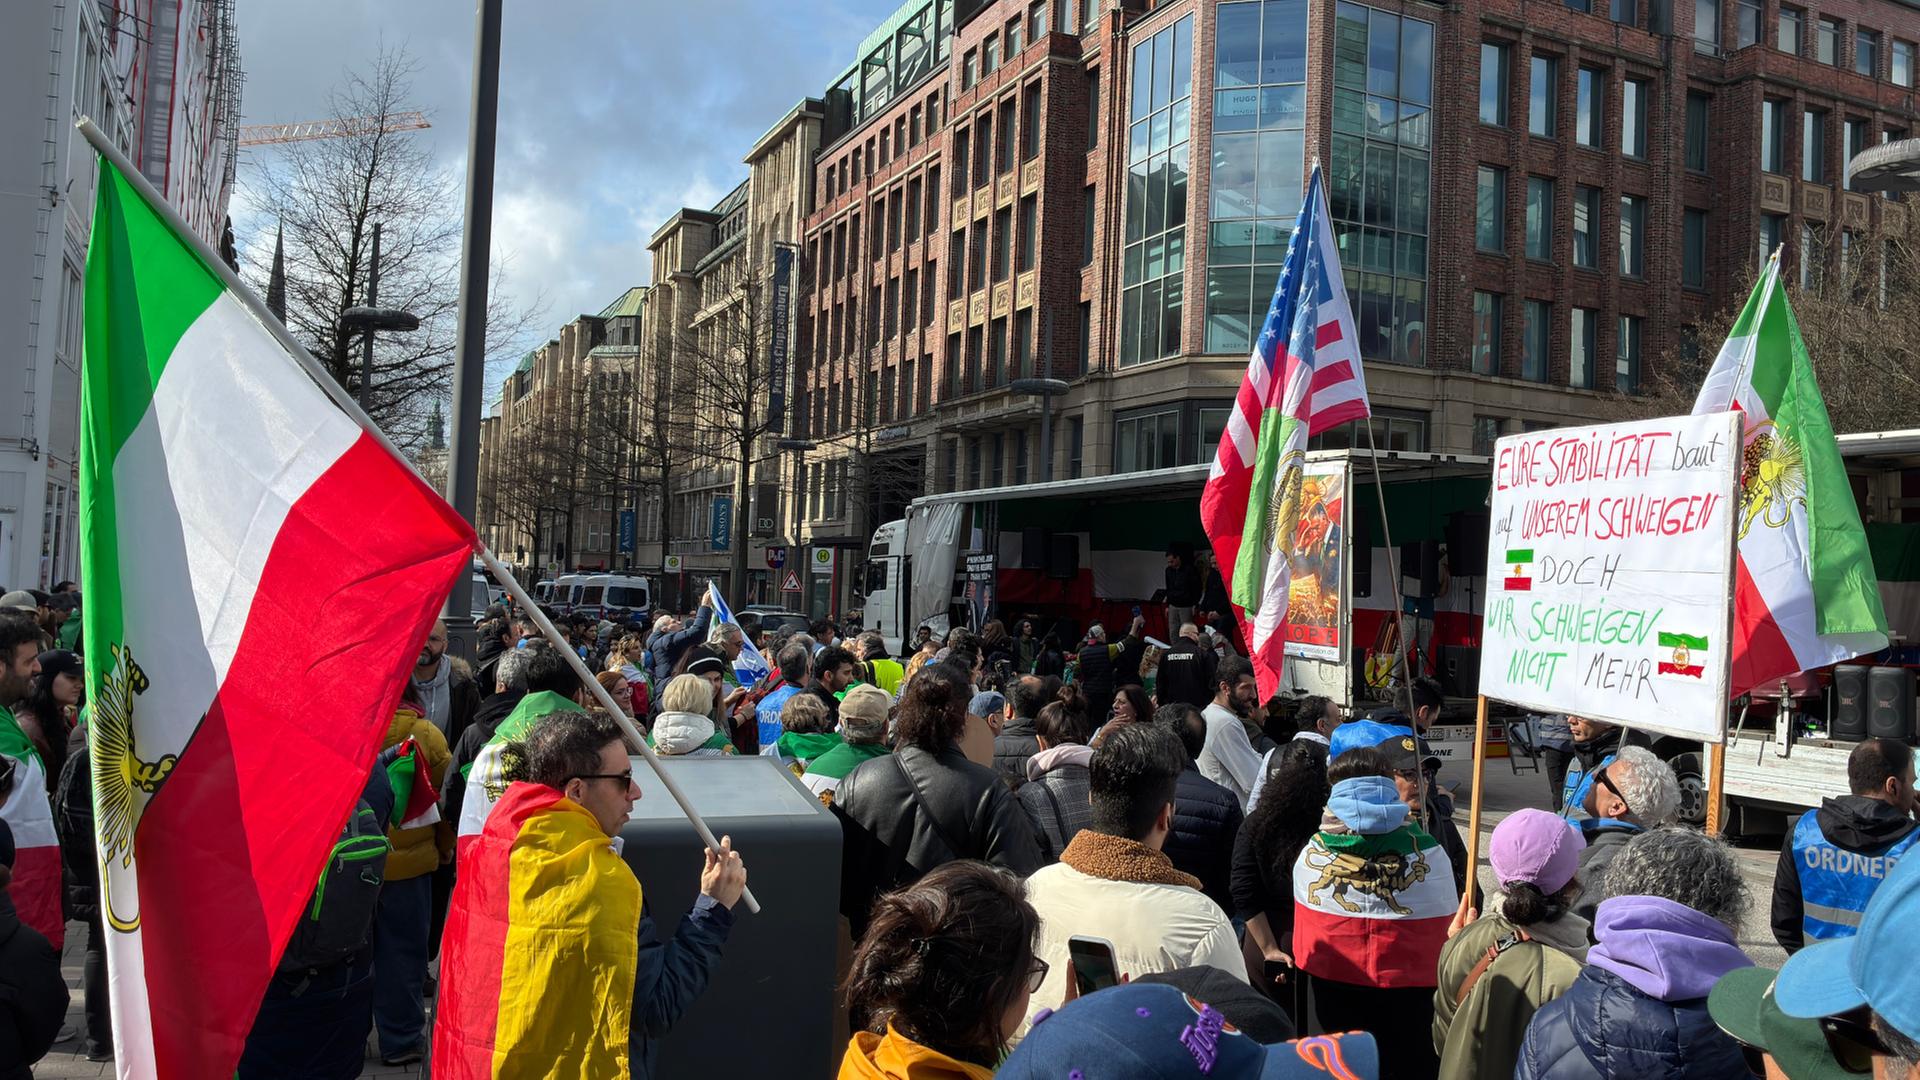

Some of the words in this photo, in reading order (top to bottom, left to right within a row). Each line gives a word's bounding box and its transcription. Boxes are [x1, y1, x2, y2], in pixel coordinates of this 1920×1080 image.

[1497, 441, 1545, 491] EURE
[1545, 432, 1672, 487] STABILITÄT
[1672, 431, 1724, 471] baut
[1495, 505, 1514, 549] auf
[1521, 499, 1590, 540] UNSEREM
[1595, 493, 1719, 540] SCHWEIGEN
[1539, 554, 1621, 591] DOCH
[1487, 597, 1517, 641] WIR
[1528, 597, 1663, 645] SCHWEIGEN
[1168, 653, 1194, 661] SECURITY
[1507, 649, 1568, 692] NICHT
[1584, 652, 1658, 703] MEHR
[760, 710, 783, 725] ORDN
